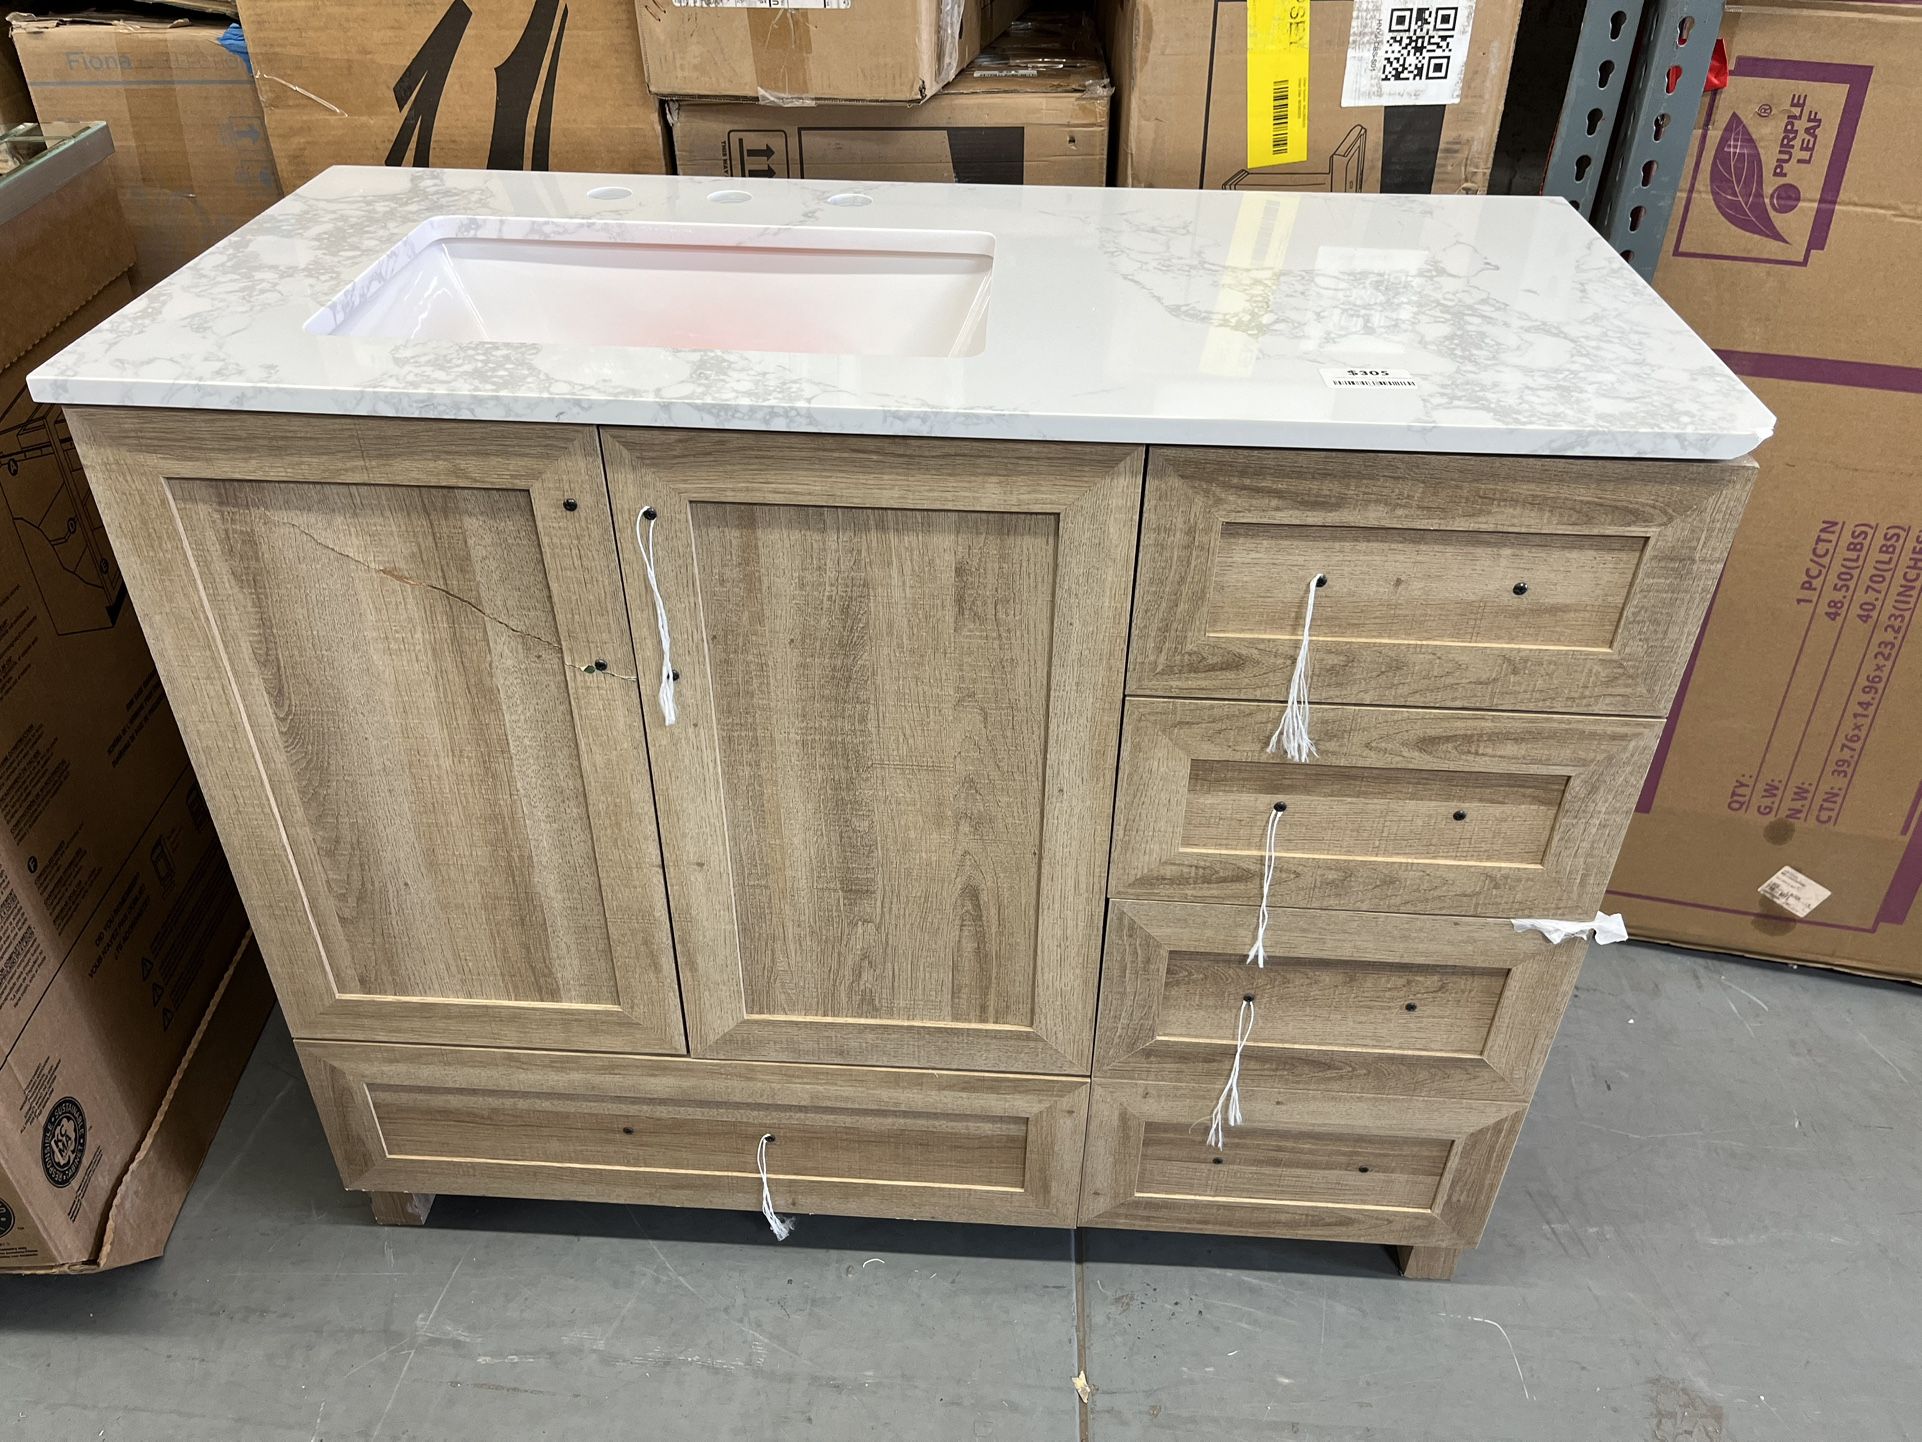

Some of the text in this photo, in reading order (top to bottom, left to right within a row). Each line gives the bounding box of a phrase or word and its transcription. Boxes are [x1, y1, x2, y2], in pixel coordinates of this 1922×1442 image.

[65, 51, 133, 70] Fiona
[1772, 93, 1807, 177] PURPLE
[1796, 110, 1822, 164] LEAF
[1727, 774, 1753, 811] QTY:
[1800, 520, 1840, 592] PC/CTN
[1757, 523, 1874, 816] G.W: 48.50(LBS)
[1785, 525, 1906, 820] N.W: 40.70(LBS)
[1815, 786, 1842, 824] CTN:
